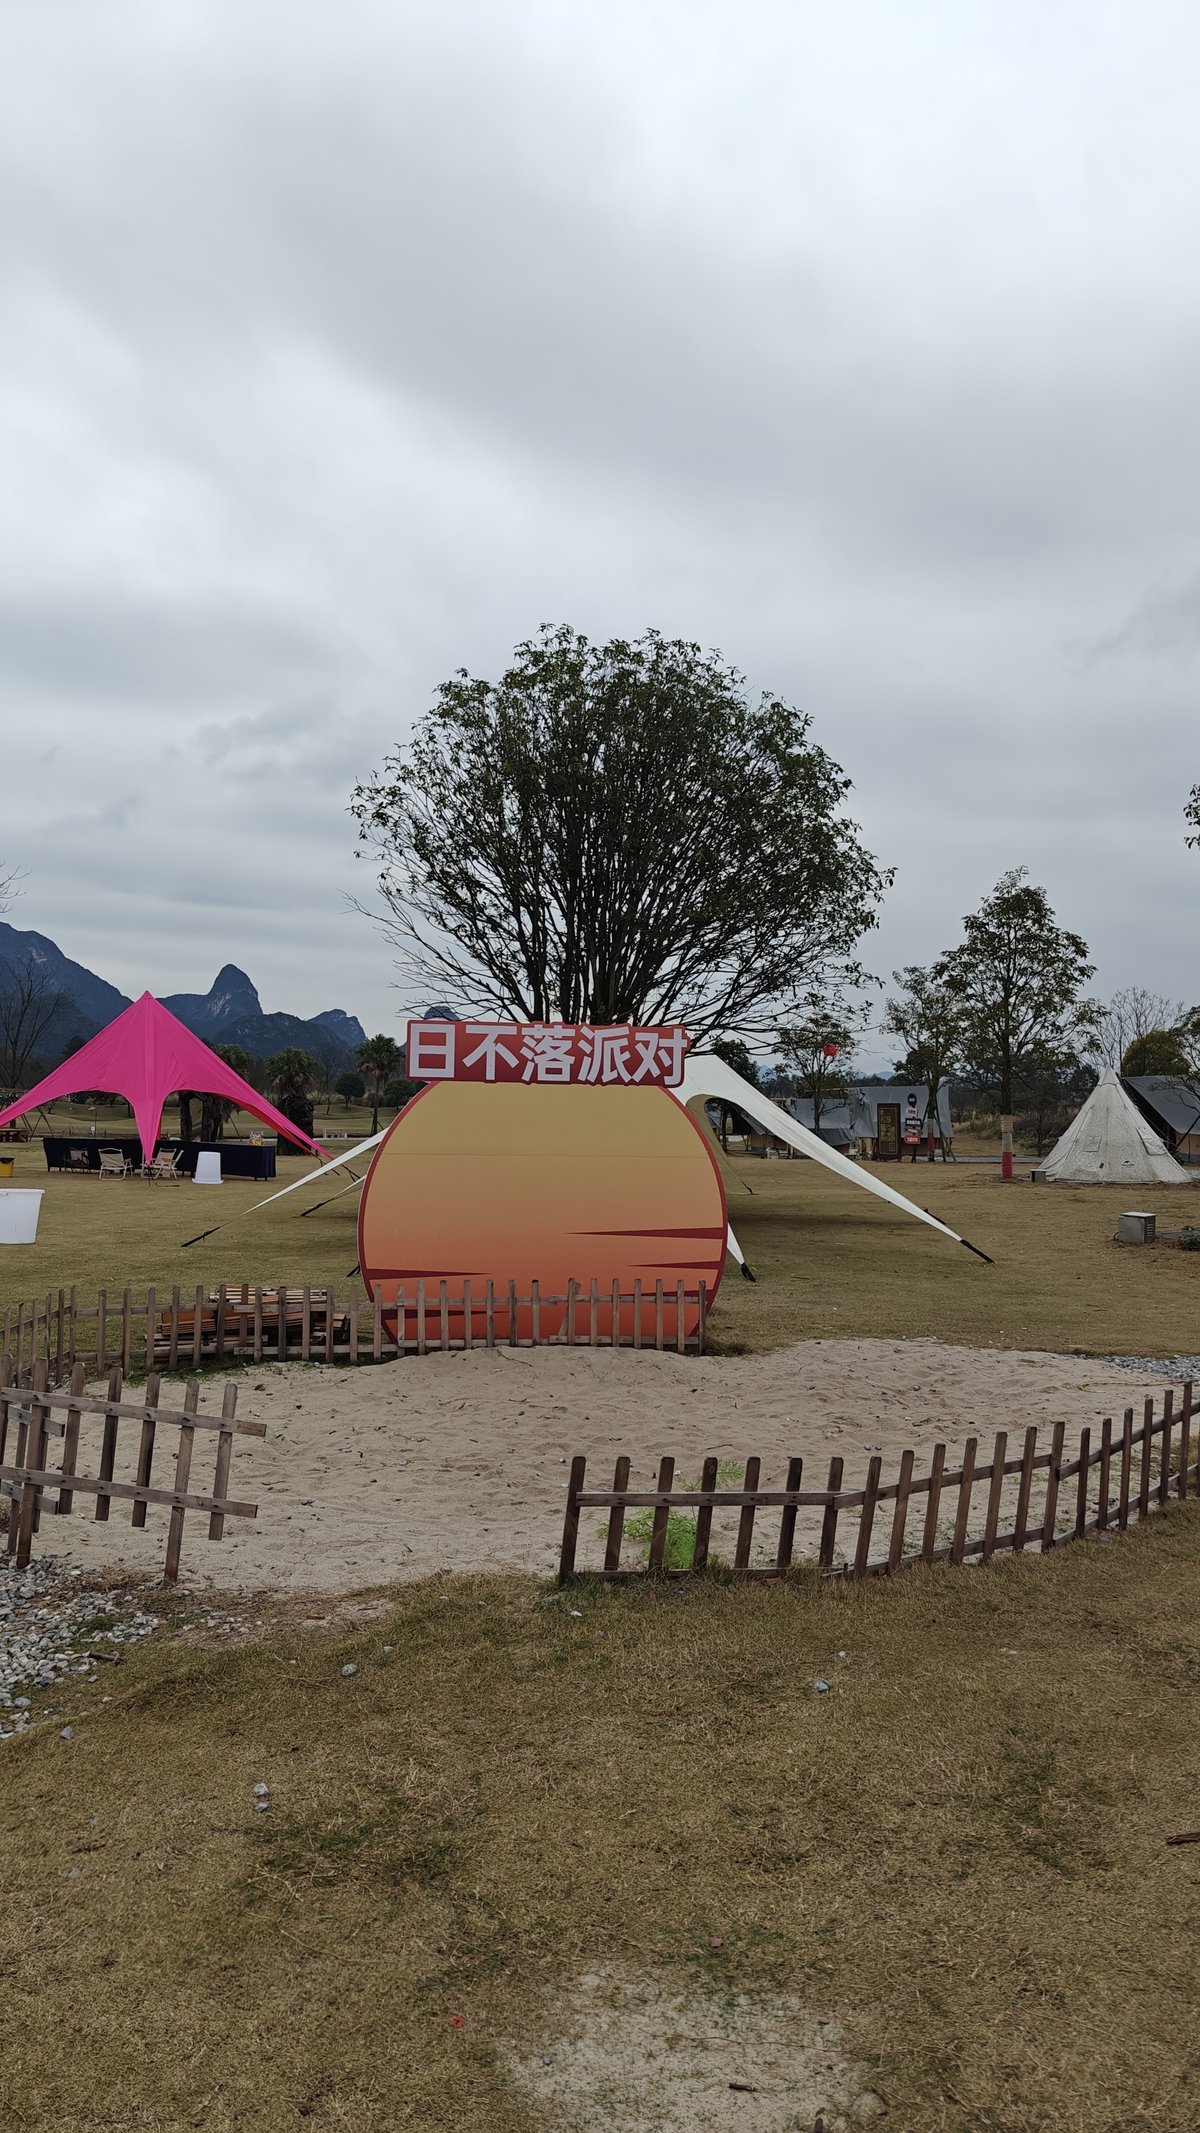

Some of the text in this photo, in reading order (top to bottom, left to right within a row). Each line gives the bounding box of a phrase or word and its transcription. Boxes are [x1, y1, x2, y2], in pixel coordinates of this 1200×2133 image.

[408, 1022, 689, 1085] 日不落派对
